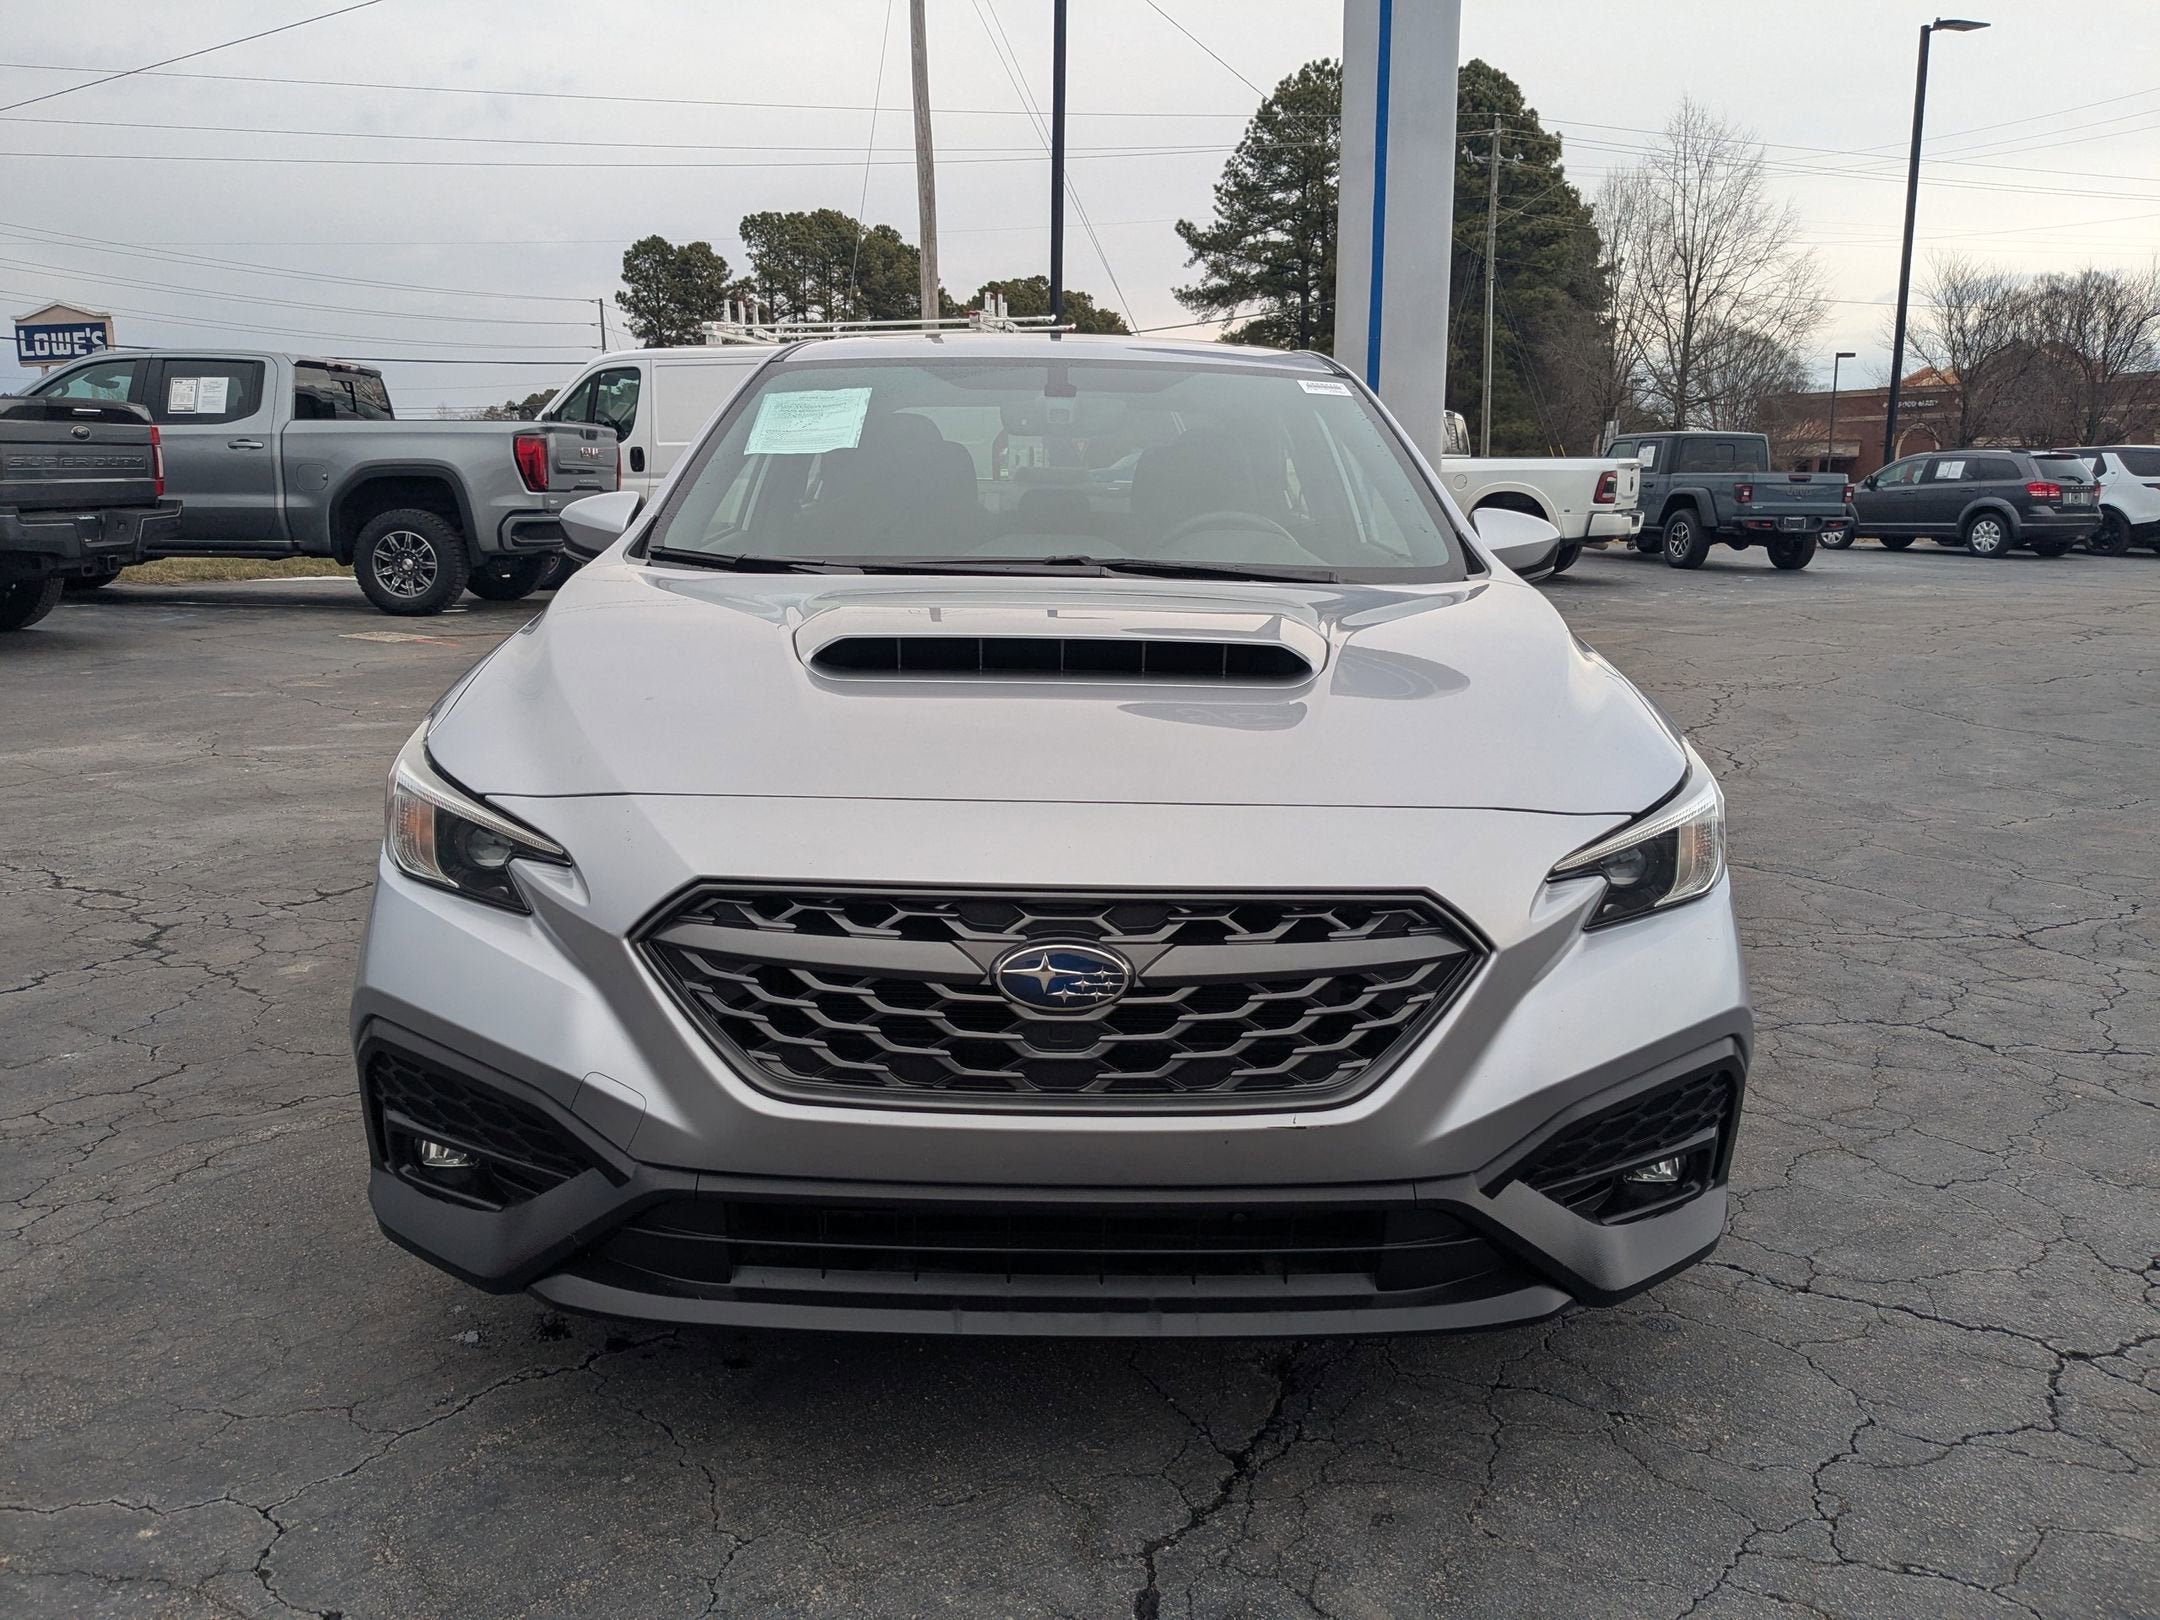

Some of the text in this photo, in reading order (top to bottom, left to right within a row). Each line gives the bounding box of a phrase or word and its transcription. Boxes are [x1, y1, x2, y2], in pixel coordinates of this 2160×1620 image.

[18, 327, 105, 357] LOWE'S
[8, 456, 143, 467] SUPER DUTY
